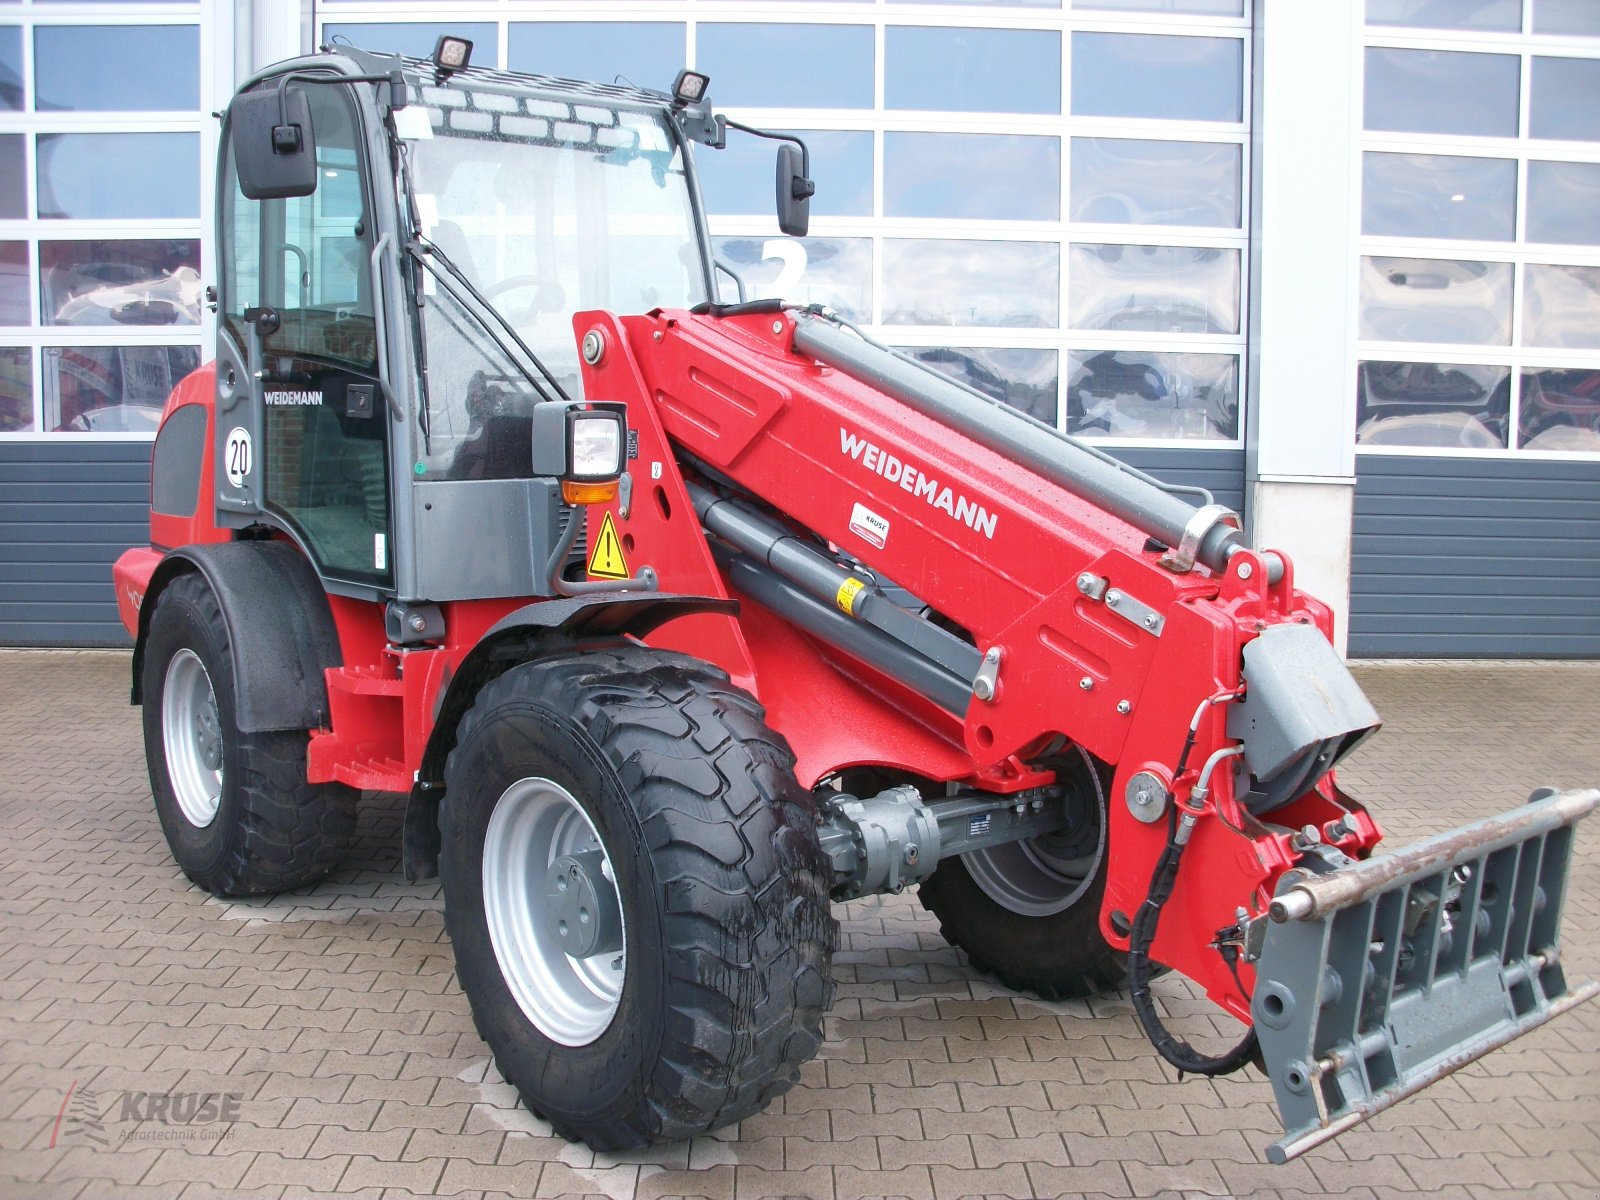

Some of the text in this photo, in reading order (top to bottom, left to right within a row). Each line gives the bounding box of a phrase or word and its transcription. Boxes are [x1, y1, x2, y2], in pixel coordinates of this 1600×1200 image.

[761, 239, 808, 304] 2
[264, 391, 323, 406] WEIDEMANN
[231, 439, 248, 475] 20
[839, 427, 998, 540] WEIDEMANN
[865, 515, 887, 532] KRUSE
